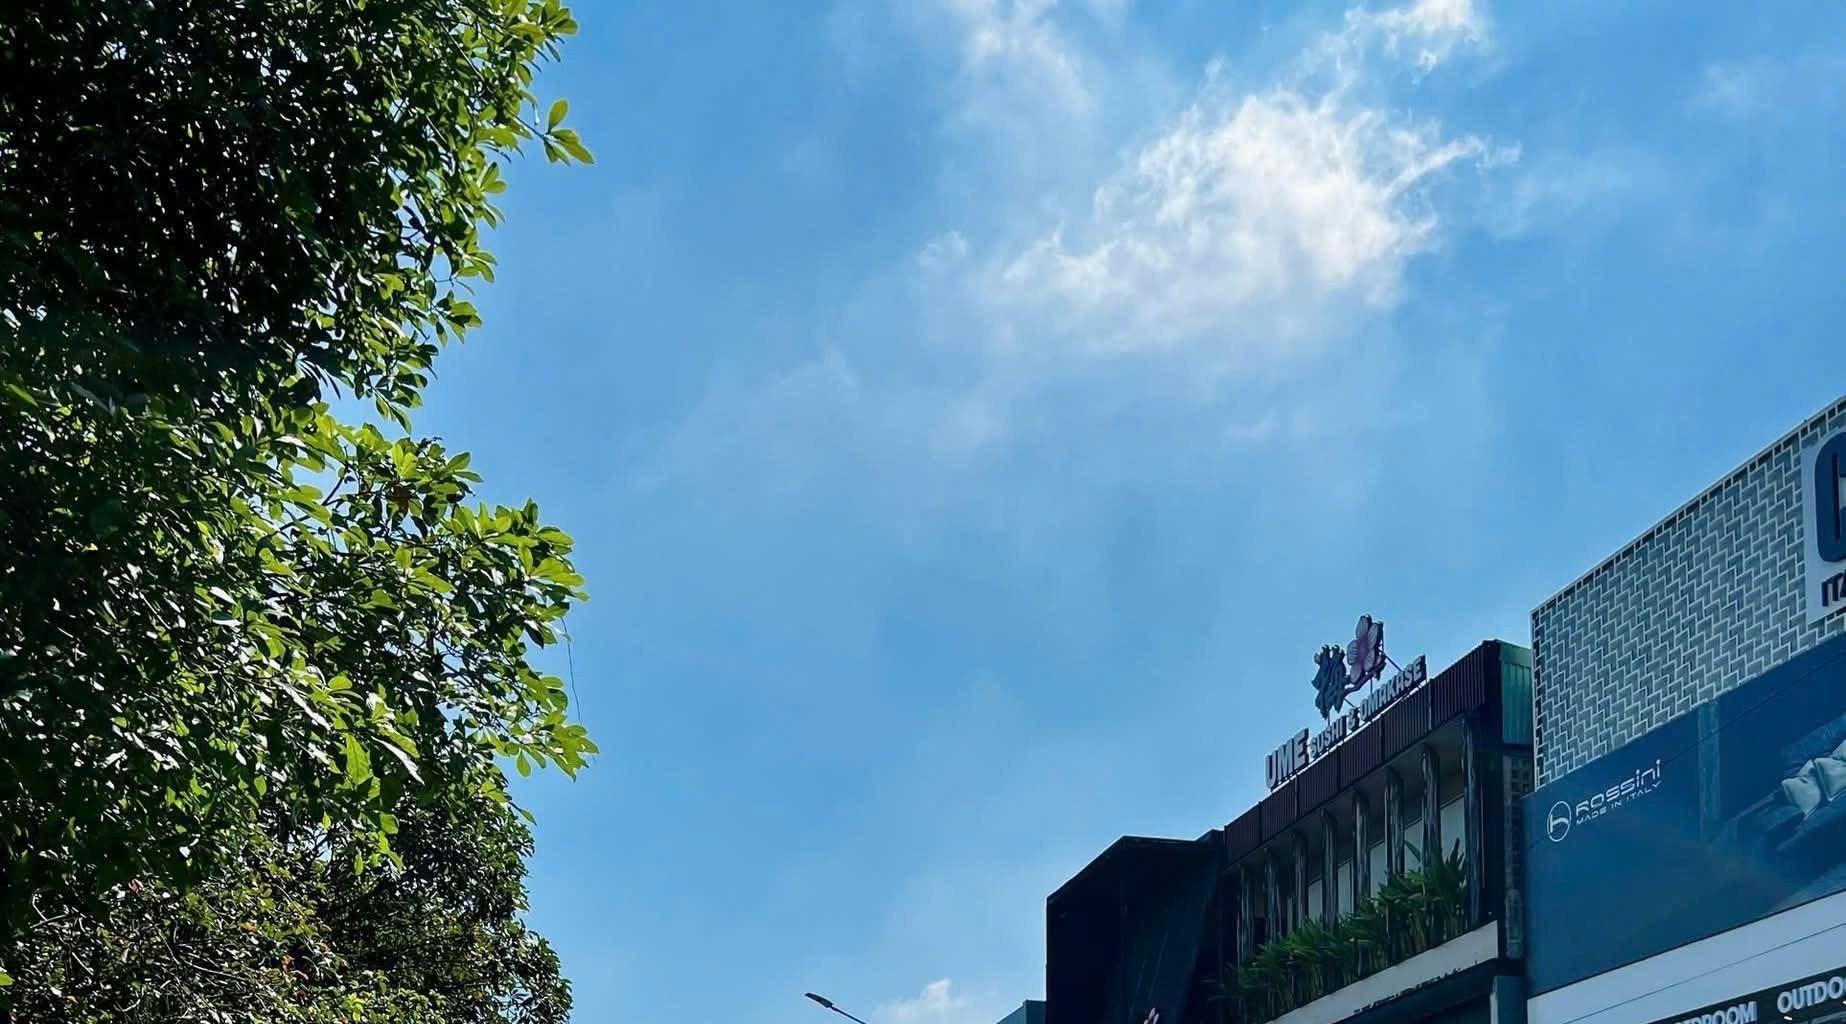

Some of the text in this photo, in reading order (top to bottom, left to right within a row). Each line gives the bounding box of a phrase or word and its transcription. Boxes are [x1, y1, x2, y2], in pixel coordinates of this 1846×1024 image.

[1265, 728, 1309, 789] UME
[1310, 715, 1347, 759] SUSHI
[1347, 708, 1360, 731] &
[1360, 654, 1427, 721] OMAKASE
[1576, 806, 1607, 825] MADE
[1611, 799, 1622, 809] IN
[1776, 976, 1846, 1014] OUTDO
